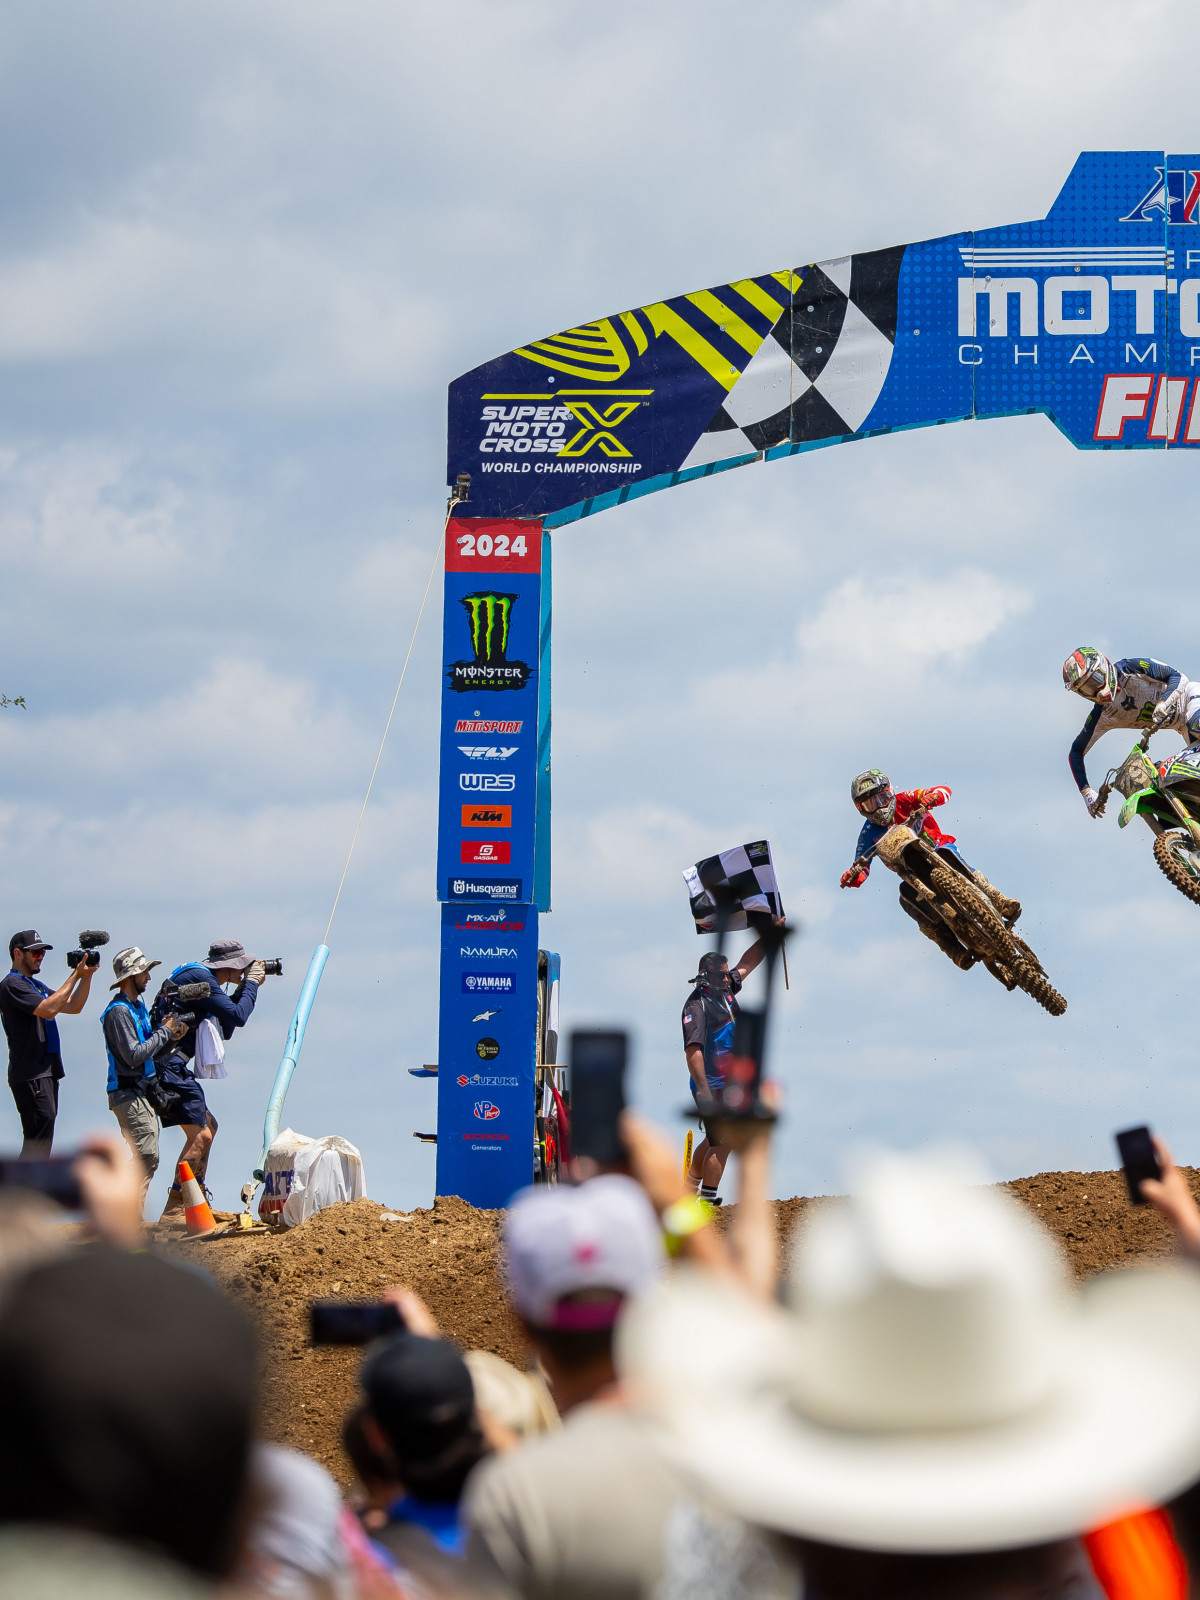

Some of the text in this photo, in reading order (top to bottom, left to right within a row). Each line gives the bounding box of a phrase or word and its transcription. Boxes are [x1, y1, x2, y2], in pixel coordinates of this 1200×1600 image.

[480, 406, 570, 421] SUPER
[486, 422, 565, 436] MOTO
[479, 438, 567, 453] CROSS
[481, 462, 642, 474] WORLD CHAMPIONSHIP
[460, 534, 527, 556] 2024
[455, 666, 522, 678] MONSTER
[465, 746, 519, 757] FLY
[460, 773, 515, 791] WPS
[471, 811, 502, 821] KTM
[466, 883, 517, 894] Husqvarna
[455, 921, 524, 931] LEGENDS
[460, 946, 517, 956] NAMURA
[477, 977, 512, 987] YAMAHA
[470, 1077, 518, 1086] SUZUKI
